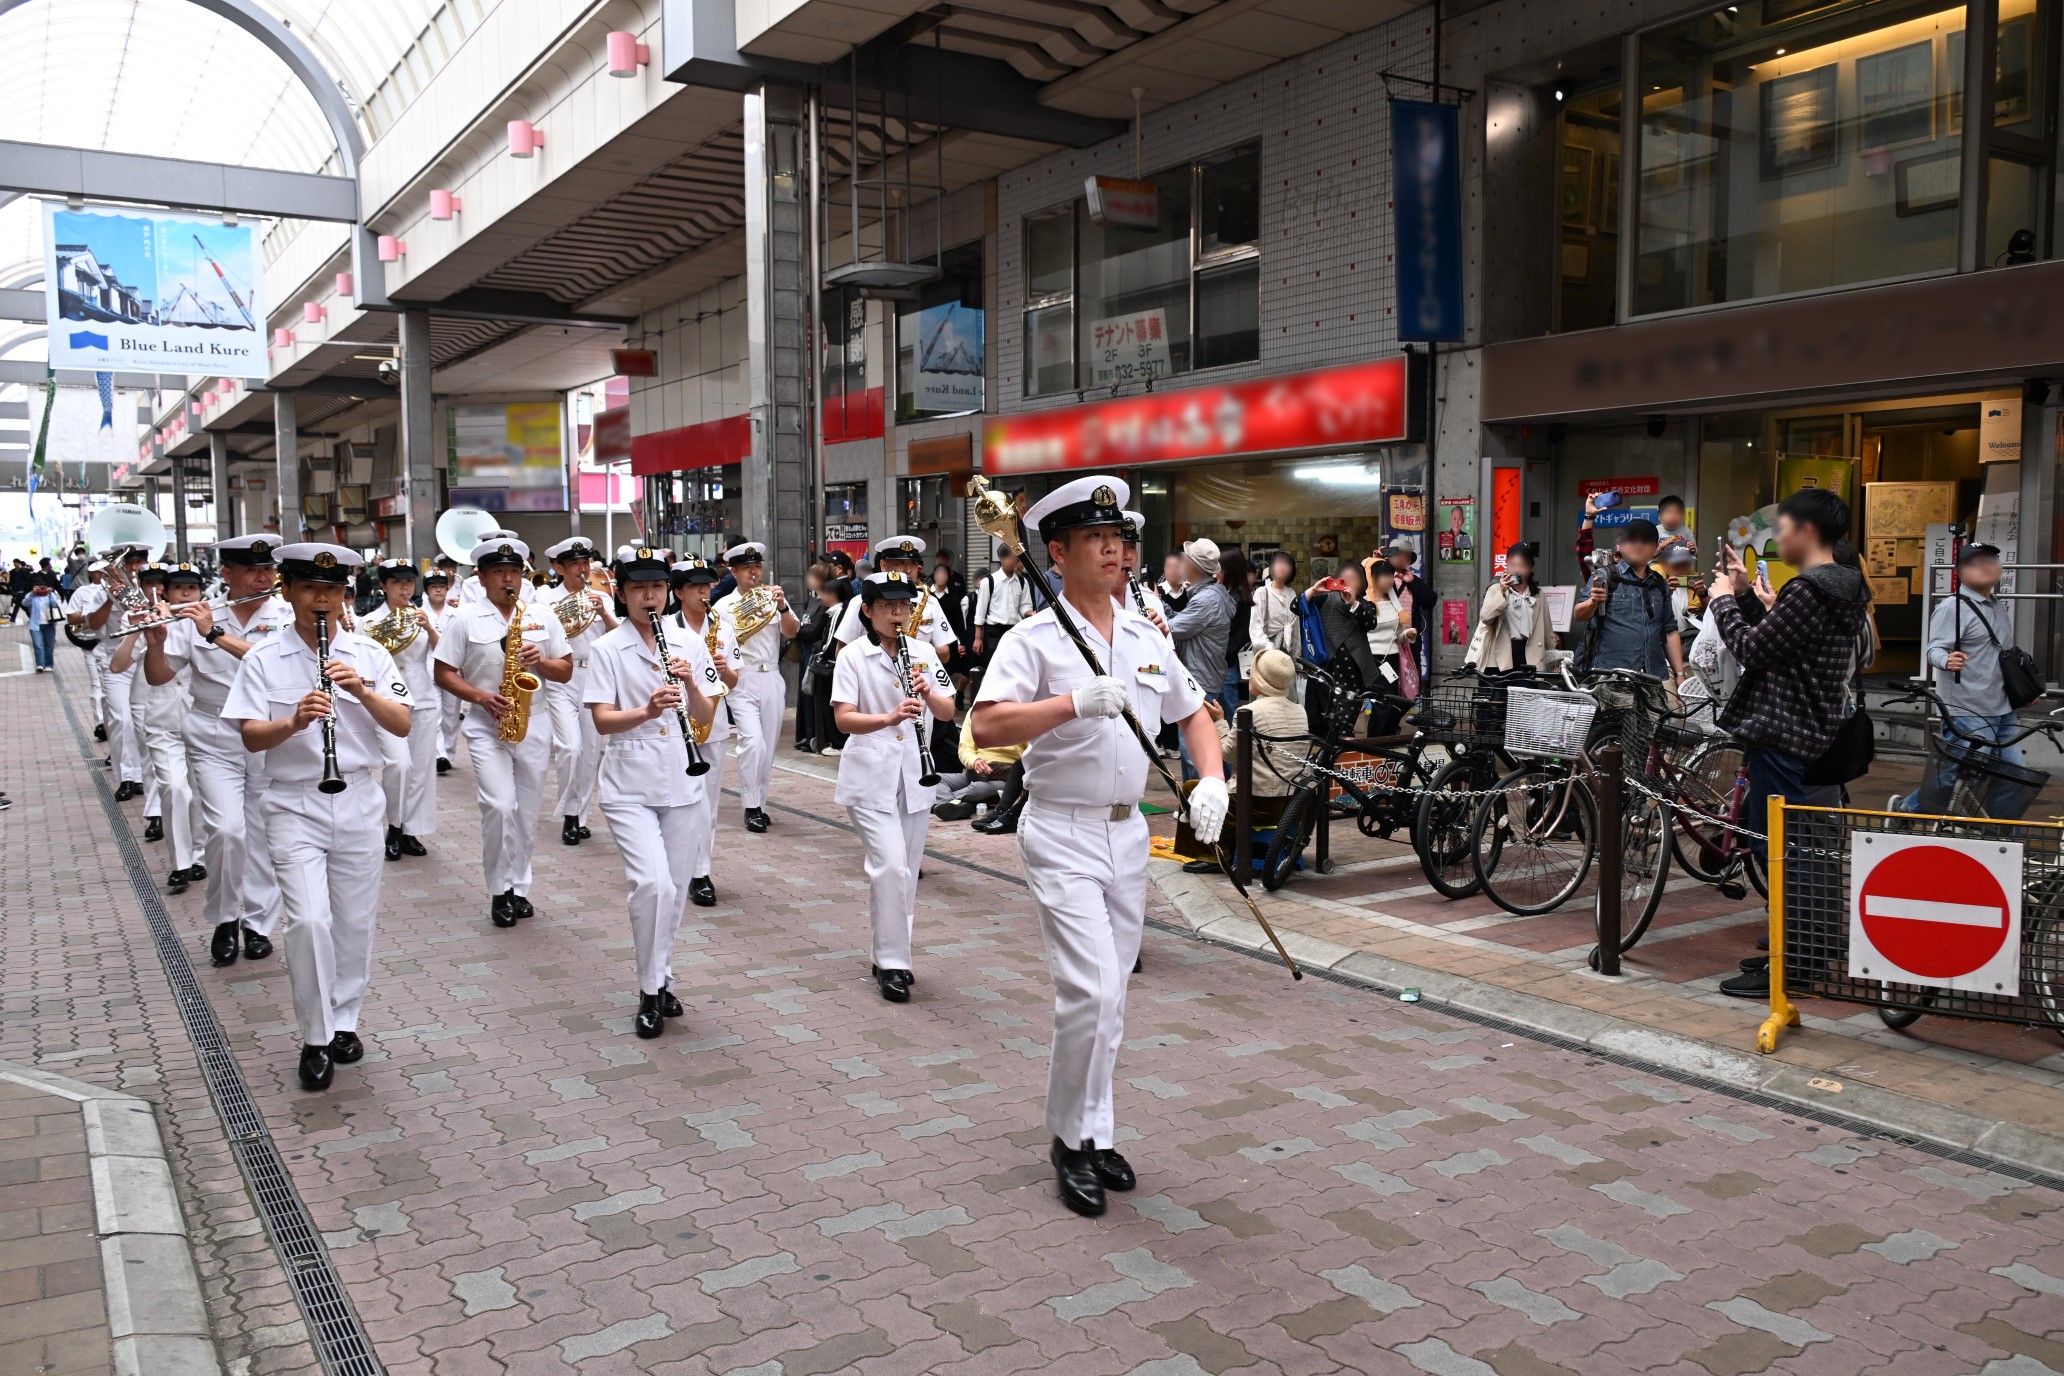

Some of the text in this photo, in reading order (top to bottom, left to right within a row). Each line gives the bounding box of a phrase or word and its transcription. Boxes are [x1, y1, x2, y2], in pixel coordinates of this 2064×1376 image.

[850, 298, 865, 375] 感謝。
[1095, 316, 1162, 348] テナント募集
[121, 338, 249, 357] Blue Land Kure
[1138, 343, 1153, 357] 3F
[1105, 349, 1118, 362] 2F
[1393, 498, 1420, 511] 工場から
[1394, 513, 1422, 526] 直接販売
